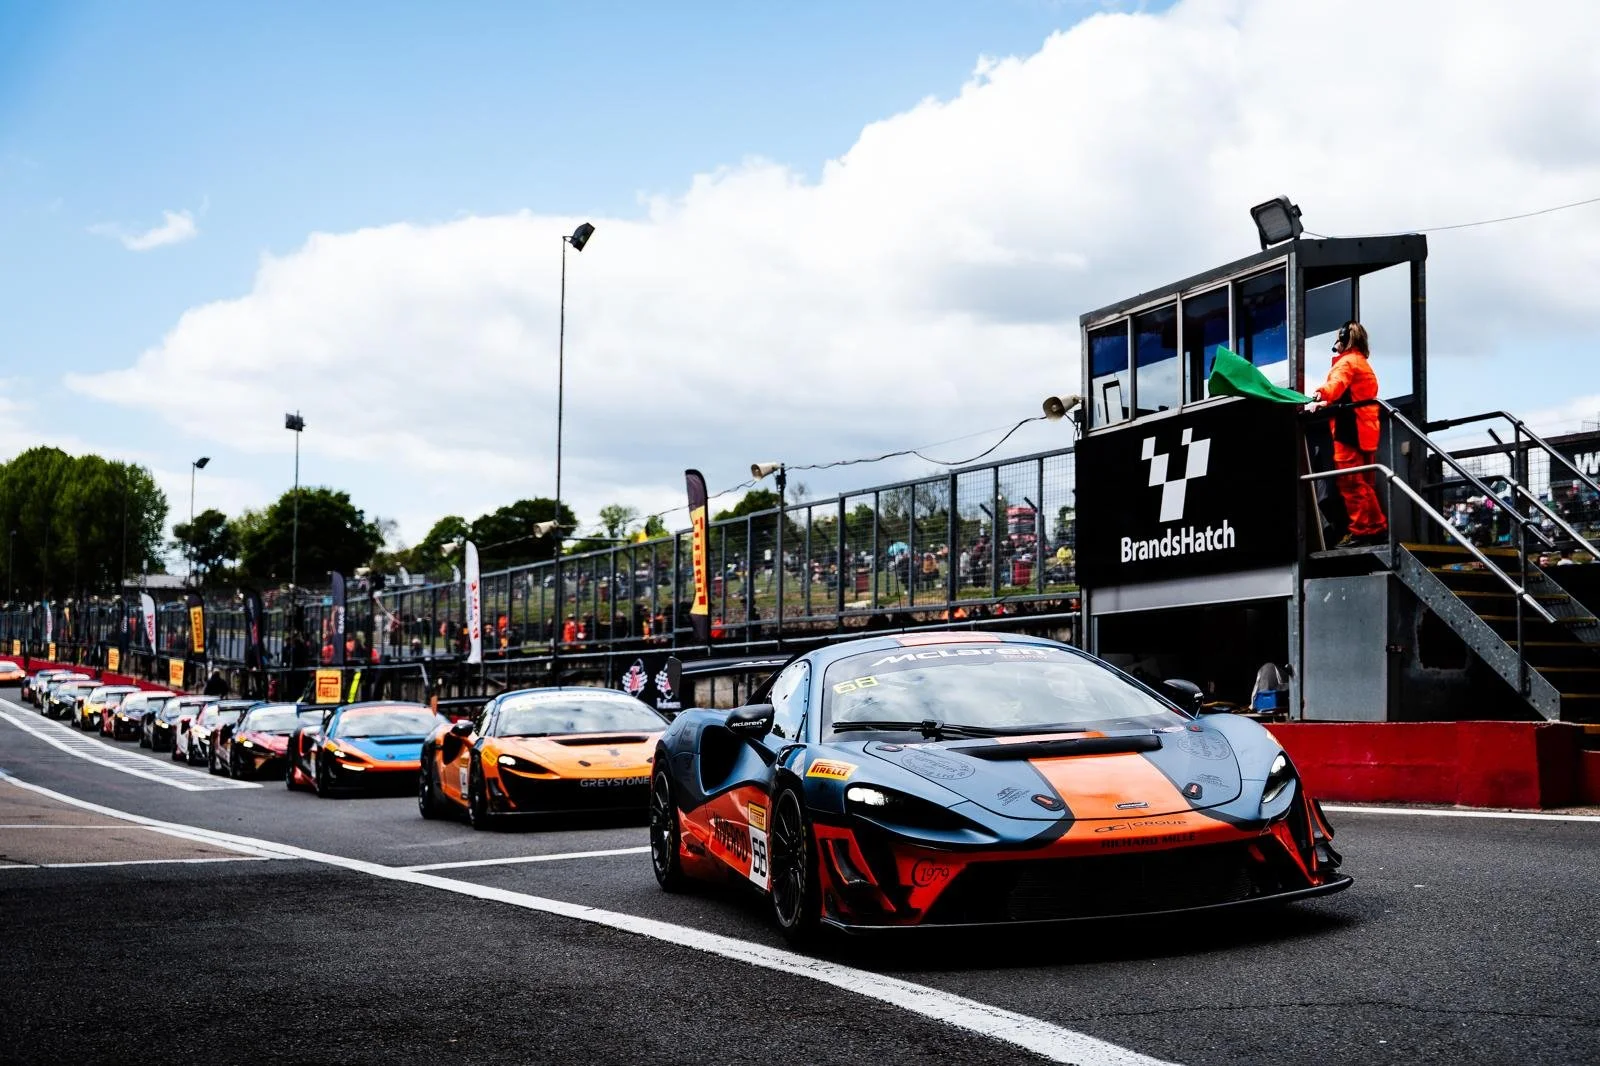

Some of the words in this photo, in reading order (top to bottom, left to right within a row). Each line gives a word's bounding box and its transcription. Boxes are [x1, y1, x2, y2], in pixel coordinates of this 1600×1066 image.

[1121, 519, 1236, 563] BrandsHatch
[870, 647, 1047, 668] McLaren
[832, 675, 880, 695] 68
[731, 719, 764, 728] McLaren
[811, 761, 850, 777] PIRELLI
[579, 776, 650, 788] GREYSTONE
[1162, 832, 1196, 844] MILLE
[752, 836, 768, 878] 68
